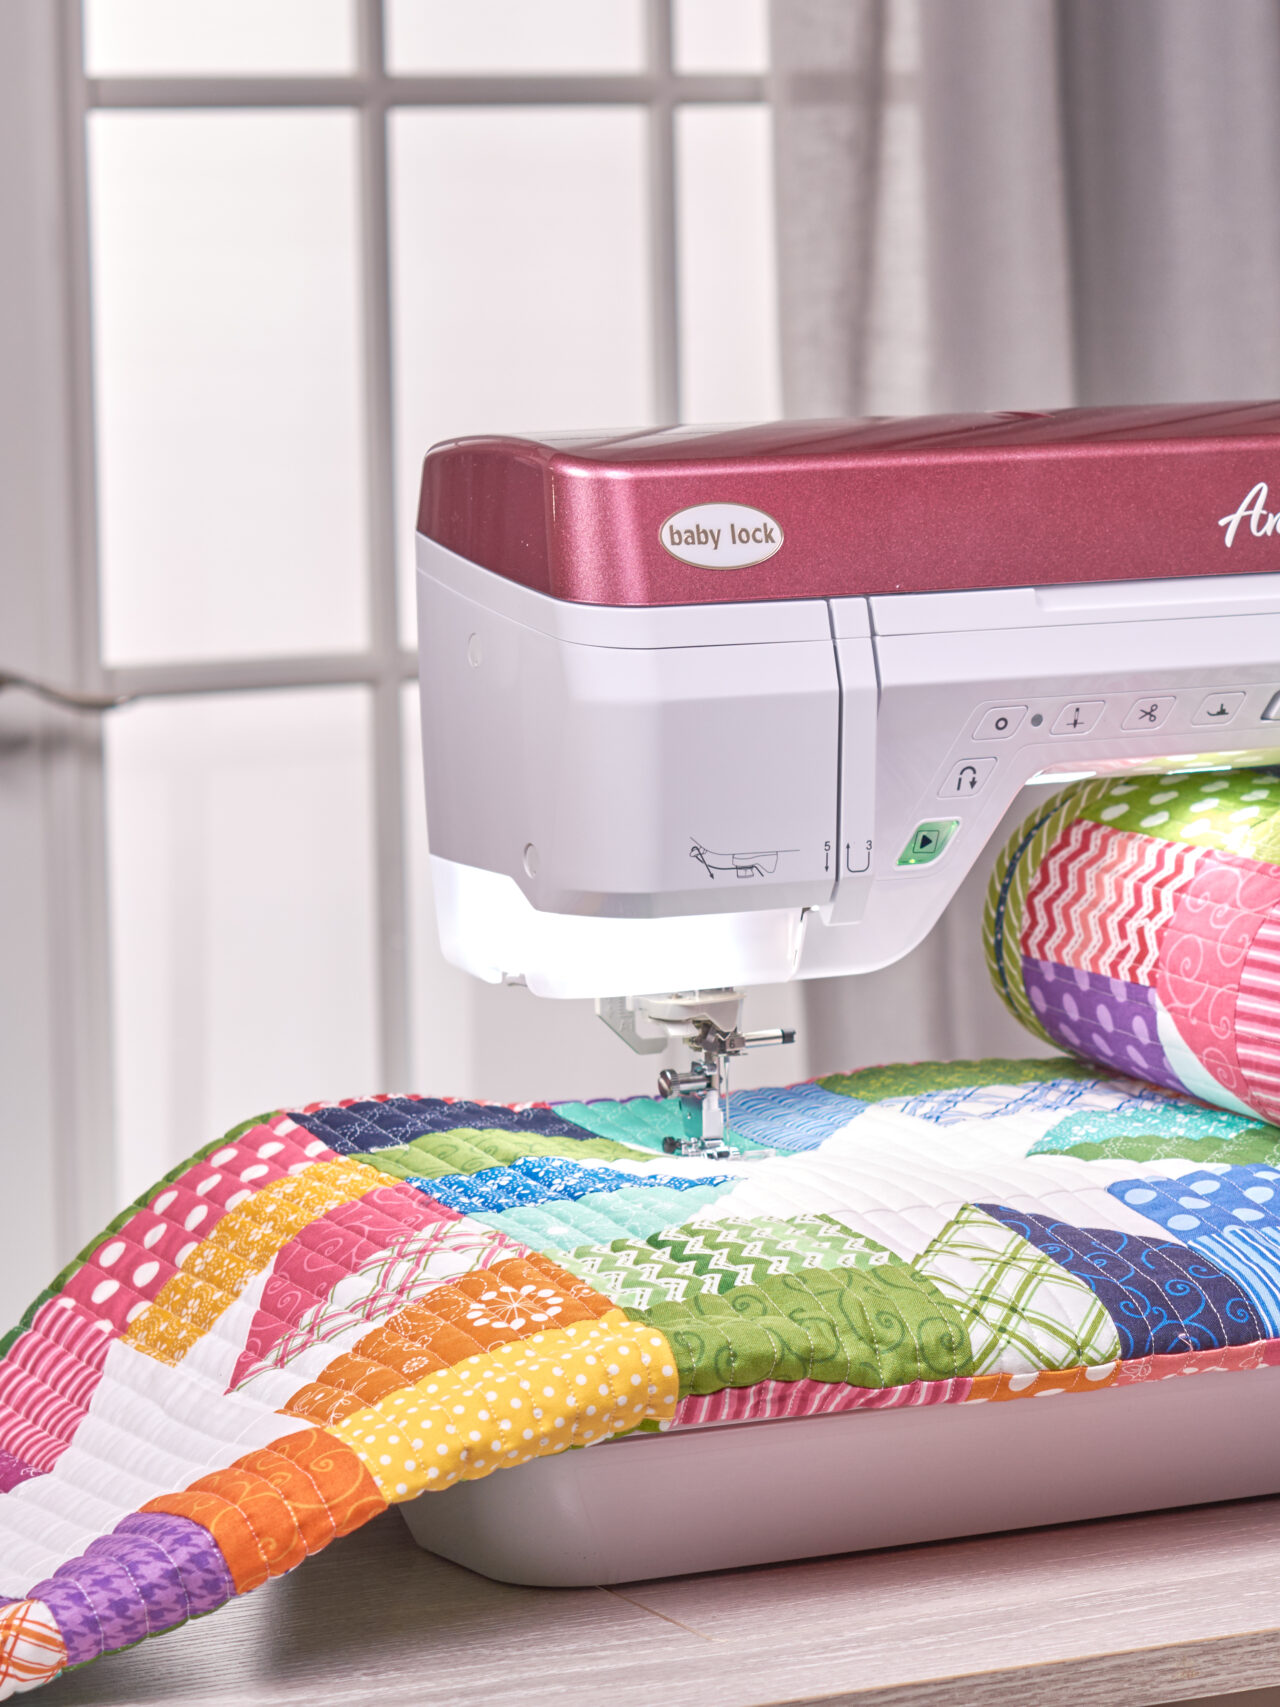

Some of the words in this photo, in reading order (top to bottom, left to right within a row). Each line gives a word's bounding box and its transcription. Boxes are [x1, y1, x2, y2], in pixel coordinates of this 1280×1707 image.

[669, 524, 721, 550] baby
[730, 522, 776, 544] lock
[824, 841, 830, 852] 5
[866, 840, 872, 850] 3
